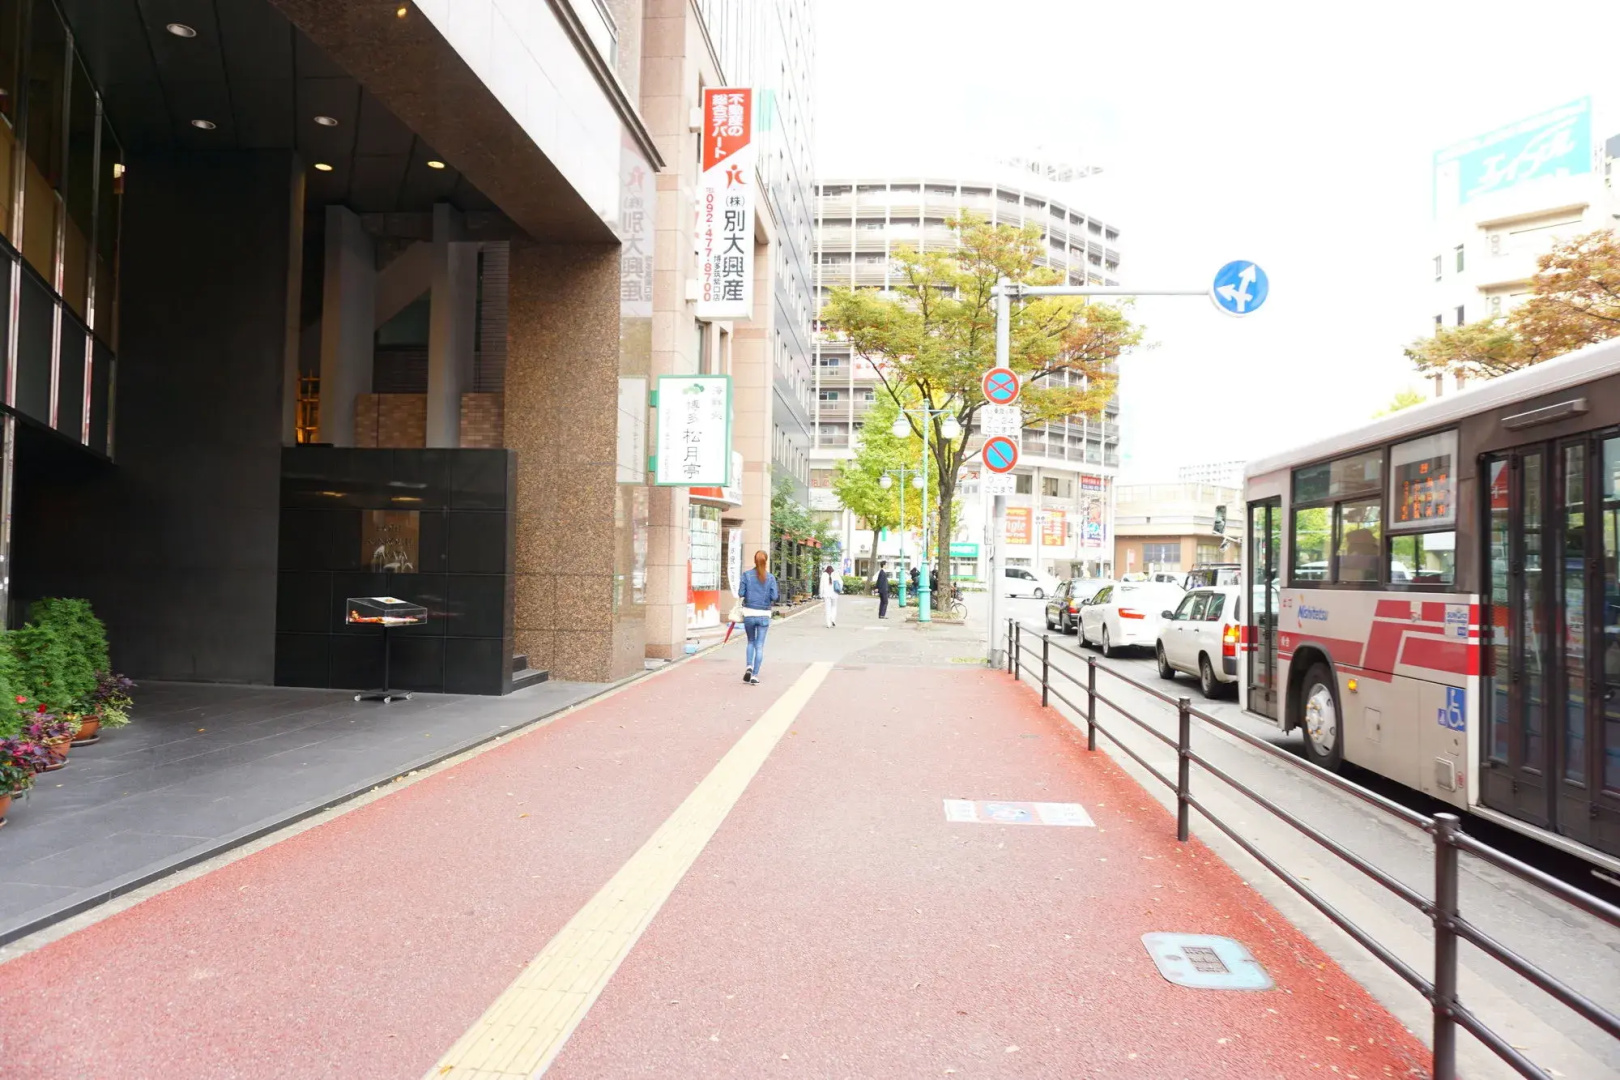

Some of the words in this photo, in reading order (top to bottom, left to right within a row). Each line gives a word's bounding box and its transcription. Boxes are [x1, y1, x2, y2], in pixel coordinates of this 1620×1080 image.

[711, 94, 727, 158] 総合デパート
[727, 94, 743, 136] 不動産の
[1297, 605, 1329, 622] Nishitetsu
